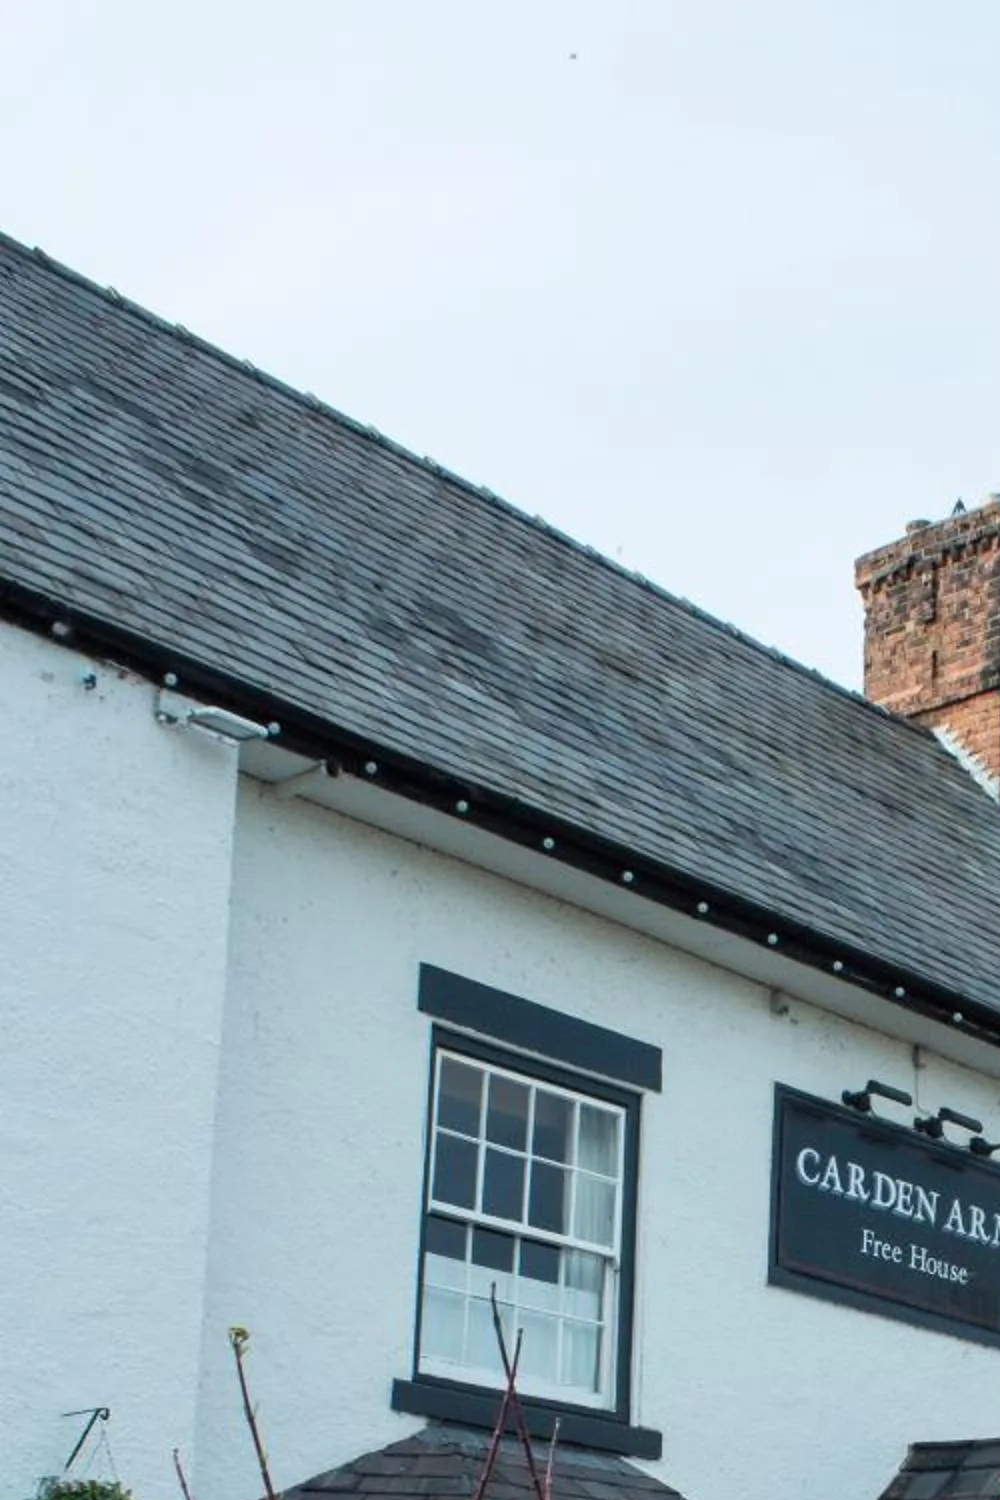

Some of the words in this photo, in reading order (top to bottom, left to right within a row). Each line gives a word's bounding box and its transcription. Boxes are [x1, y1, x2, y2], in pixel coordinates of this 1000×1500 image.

[796, 1146, 942, 1226] CARDEN
[860, 1227, 903, 1264] Free
[908, 1243, 970, 1286] House
